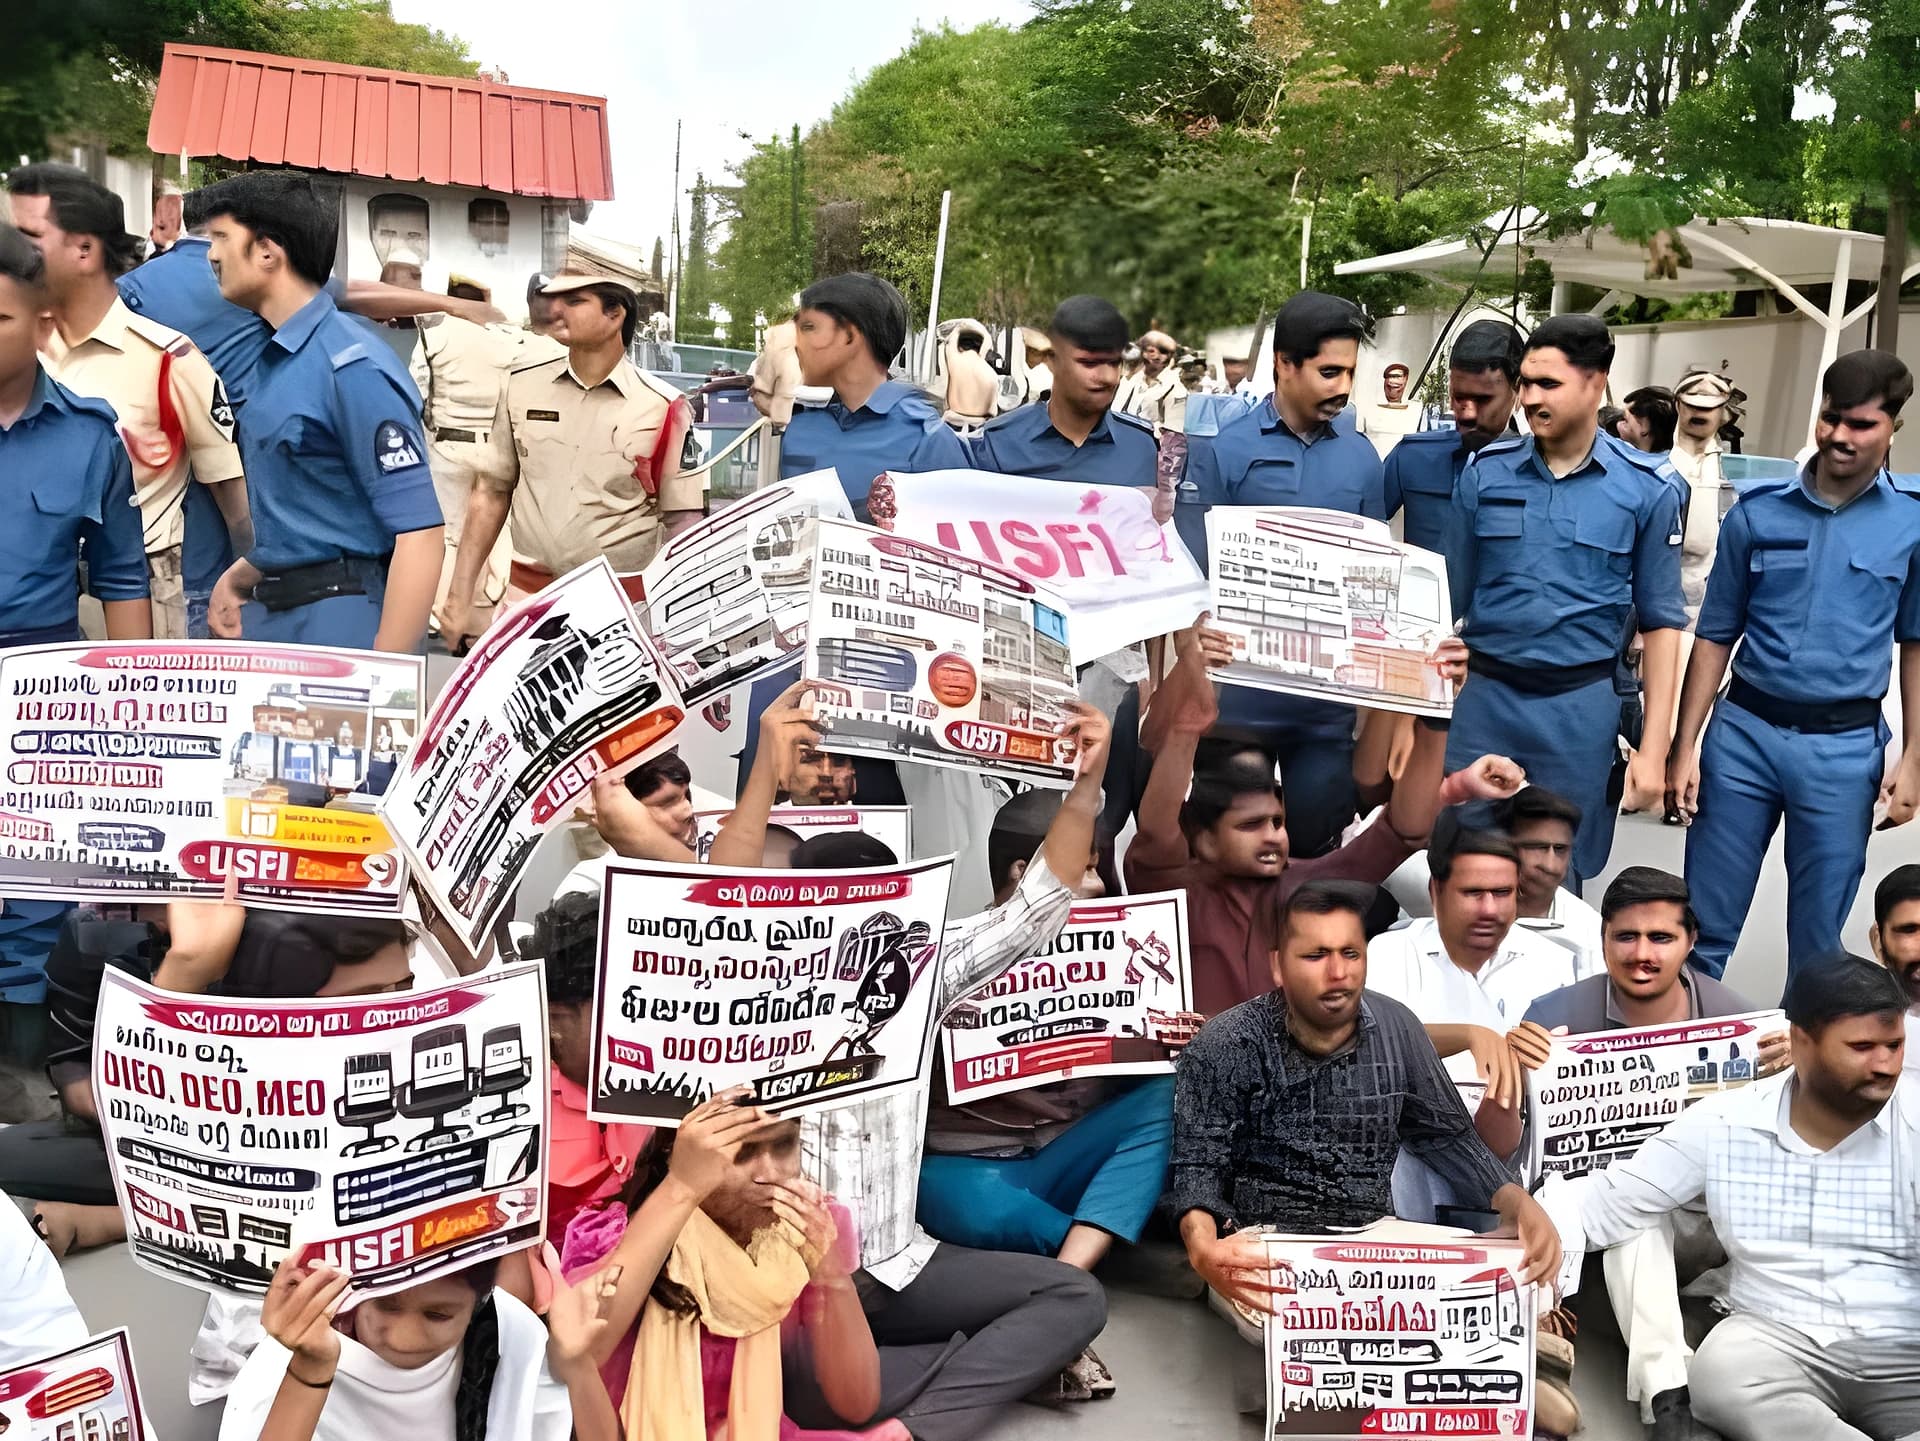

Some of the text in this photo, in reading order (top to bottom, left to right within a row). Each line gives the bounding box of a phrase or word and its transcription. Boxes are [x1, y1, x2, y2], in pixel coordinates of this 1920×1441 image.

[937, 521, 1127, 578] USFI
[210, 846, 288, 880] USFI
[257, 1080, 325, 1116] MEO
